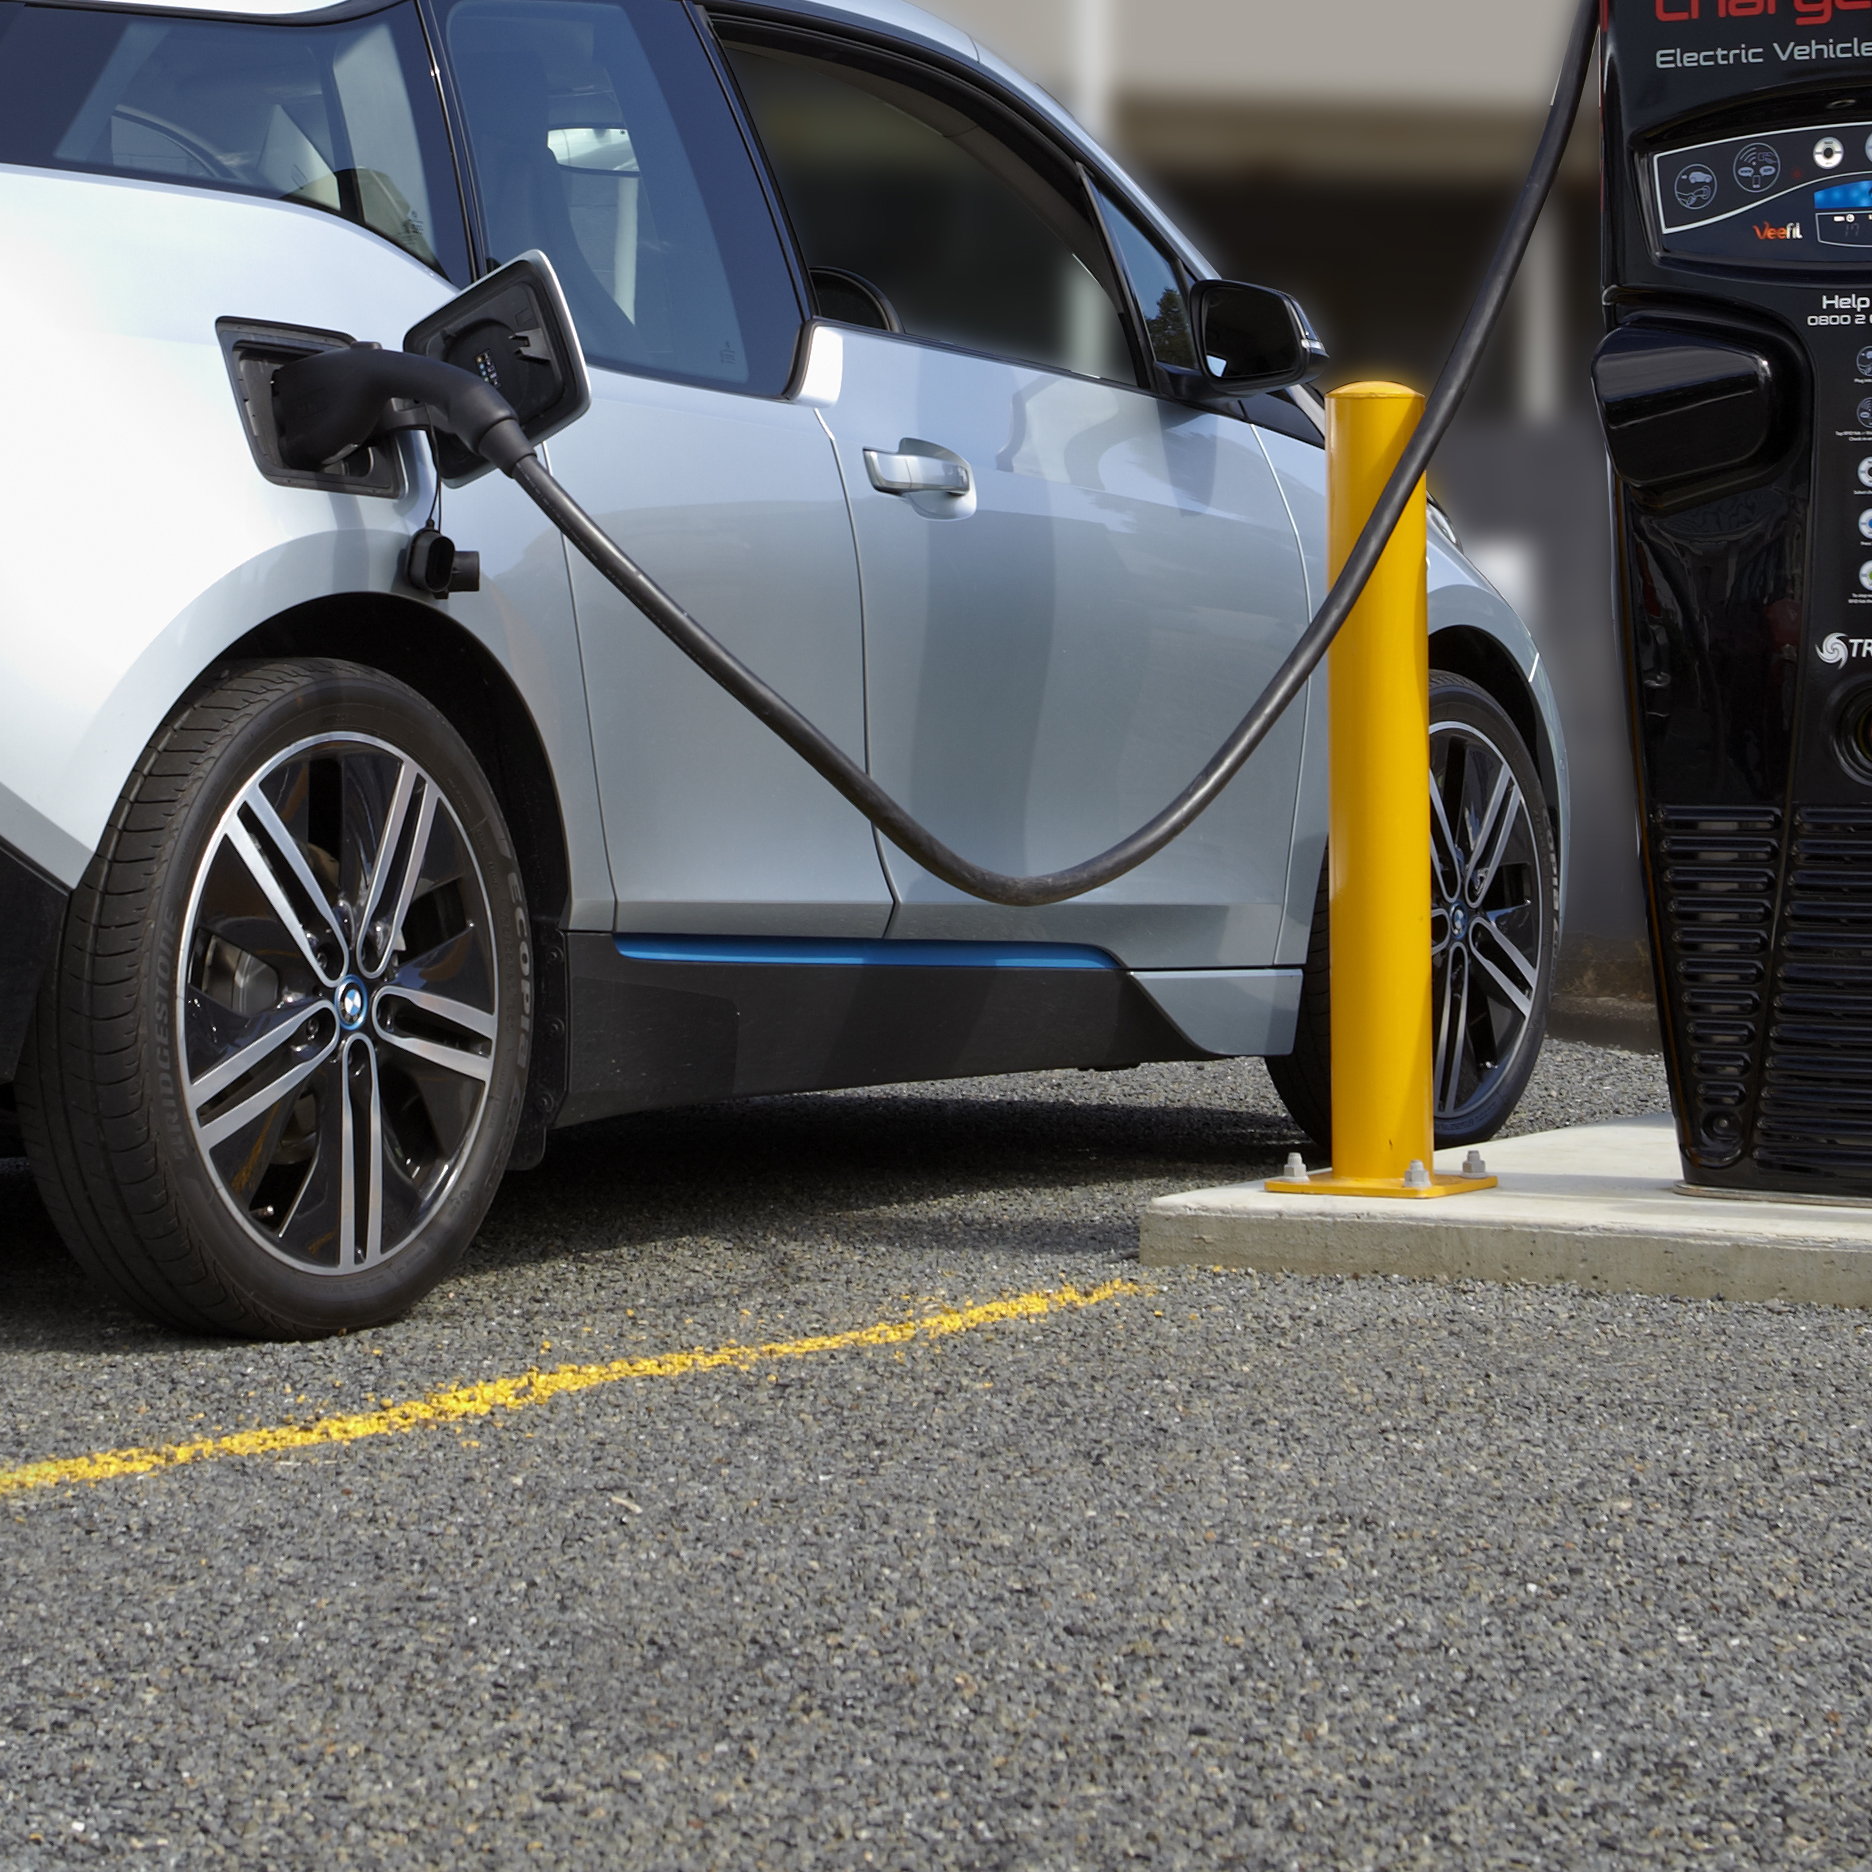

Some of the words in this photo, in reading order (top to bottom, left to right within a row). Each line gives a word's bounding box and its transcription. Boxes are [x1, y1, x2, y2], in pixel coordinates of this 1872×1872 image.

[1655, 42, 1764, 69] Electric
[1753, 221, 1803, 240] Veefil
[1822, 293, 1870, 312] Help
[1807, 314, 1851, 326] 0800
[1854, 314, 1866, 325] 2
[508, 872, 531, 1069] ECOPIA
[155, 907, 189, 1160] BRIDGESTONE
